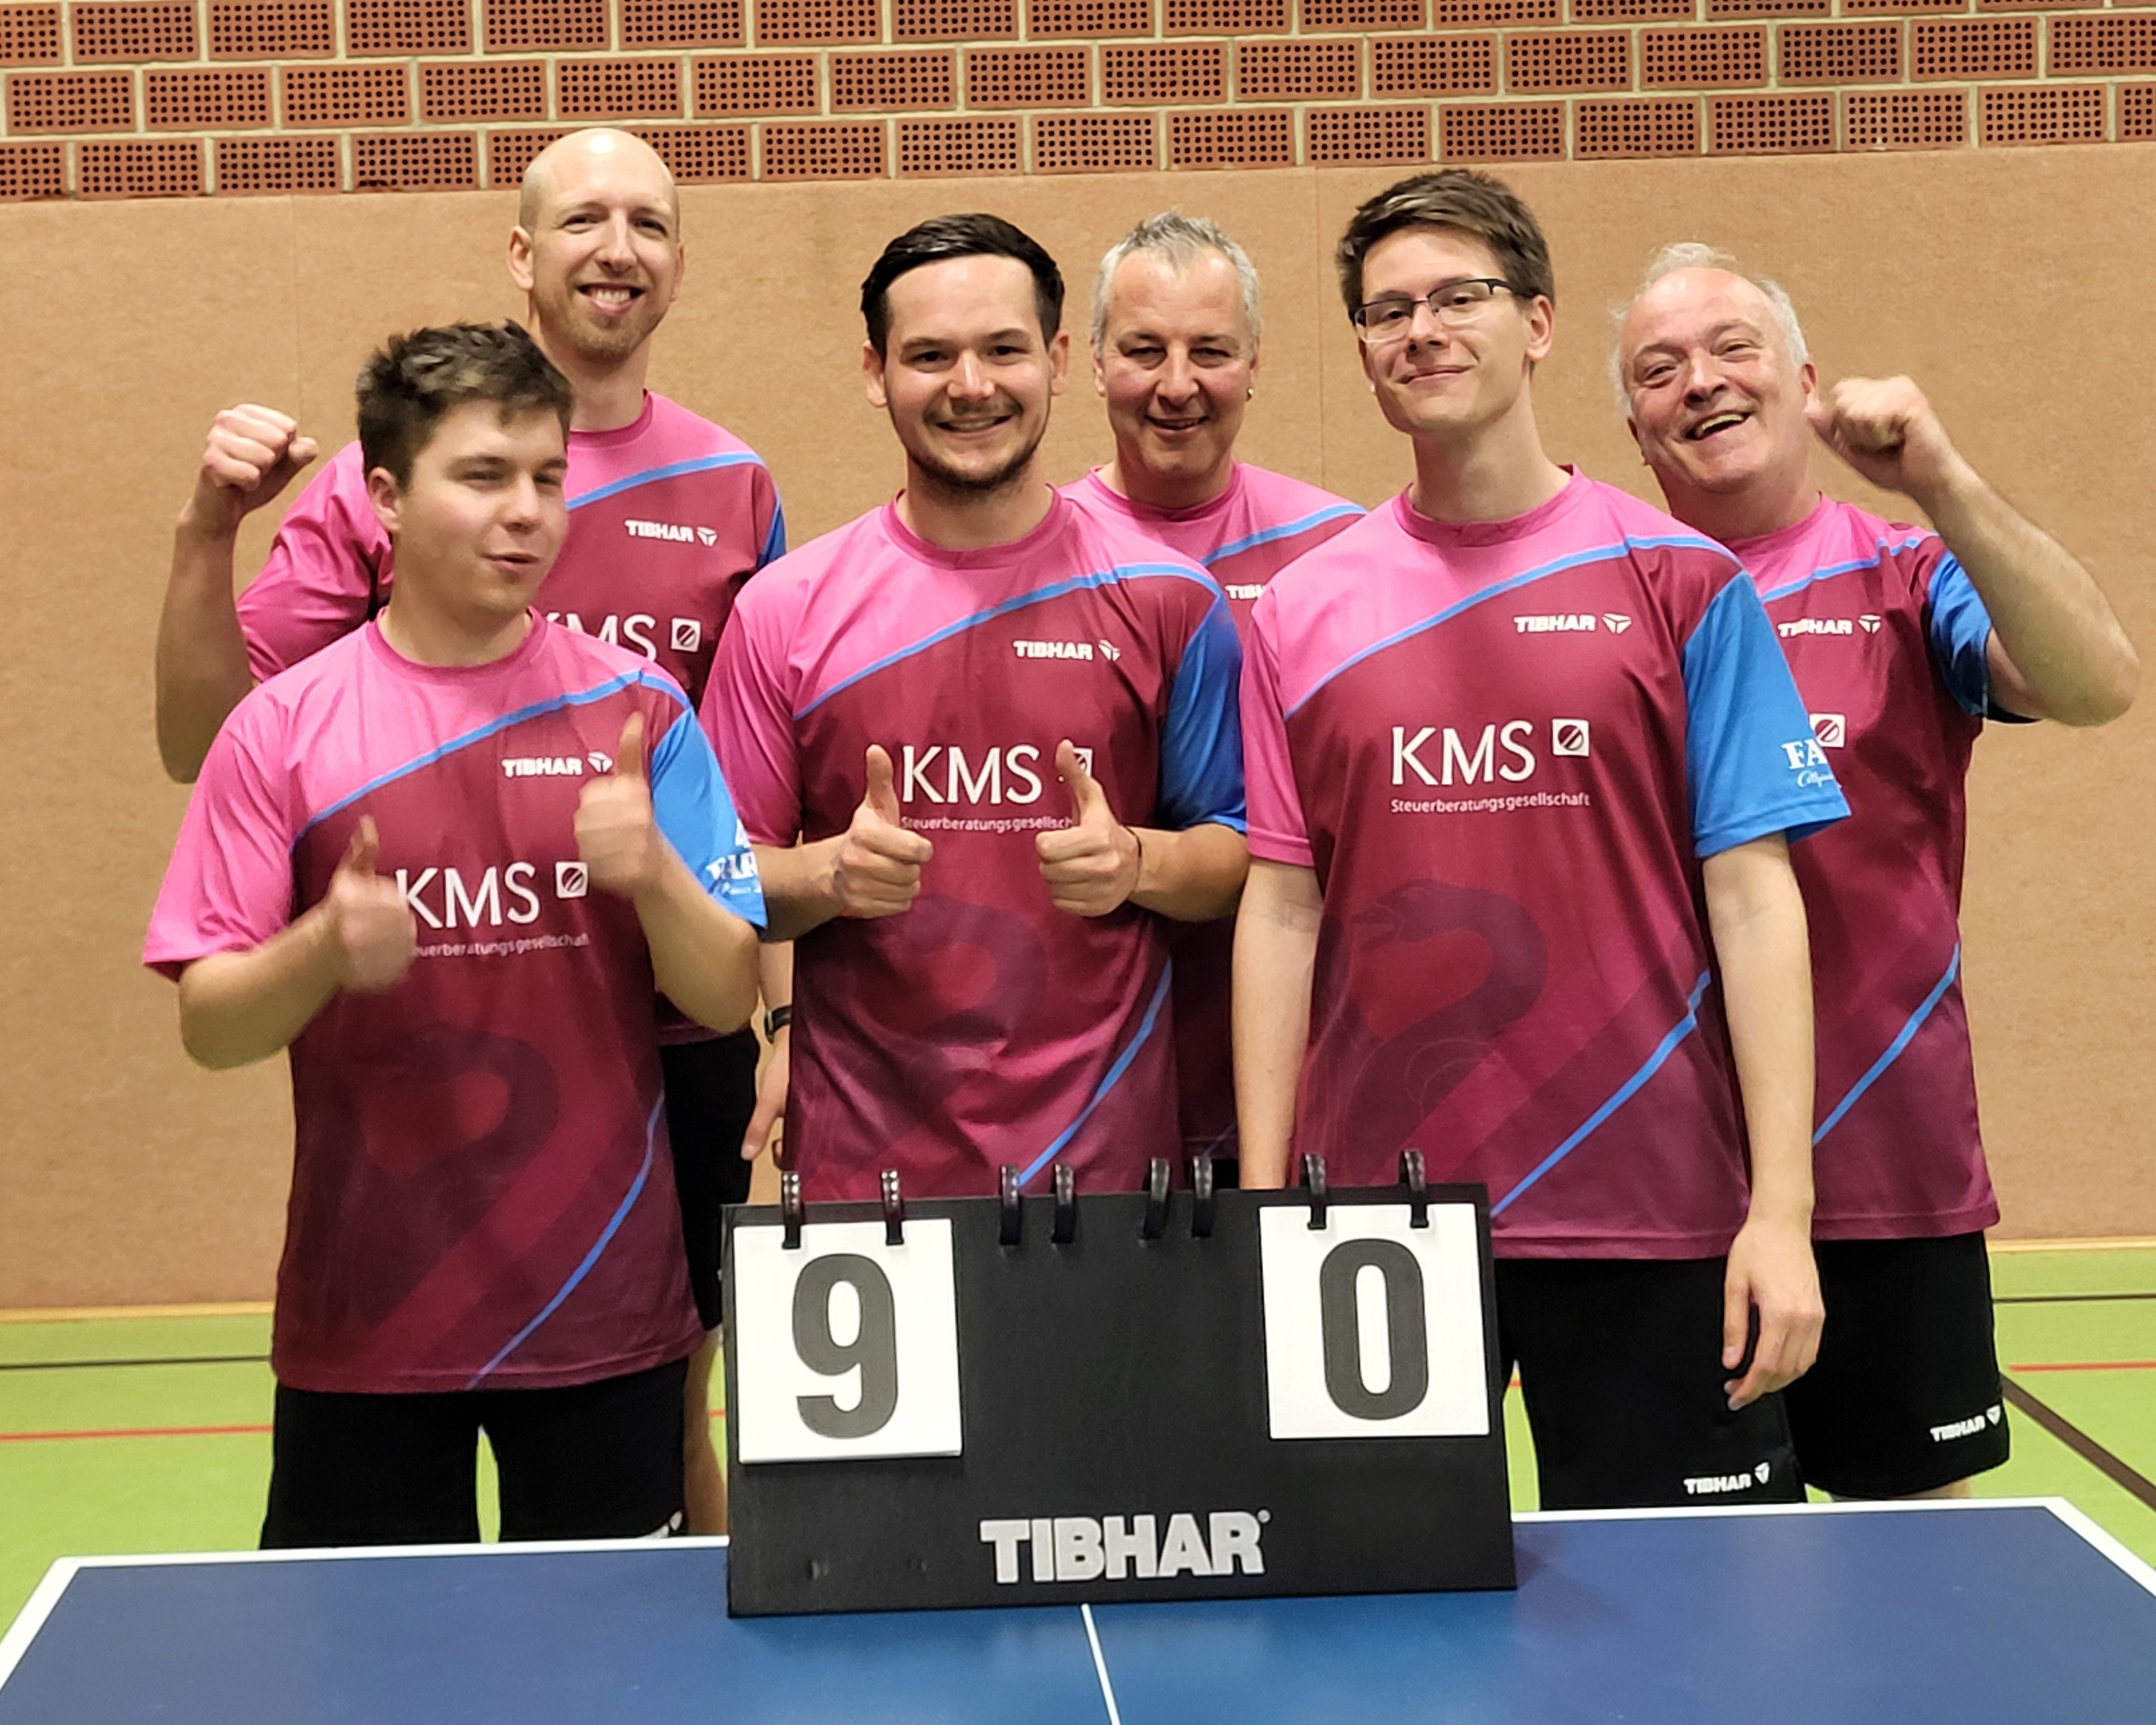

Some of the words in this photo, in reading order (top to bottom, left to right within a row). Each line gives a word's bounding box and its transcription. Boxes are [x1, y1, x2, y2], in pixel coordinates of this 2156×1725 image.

[625, 520, 694, 542] TIBHAR
[1514, 615, 1596, 633] TIBHAR
[1013, 641, 1093, 661] TIBHAR
[1392, 720, 1537, 785] KMS
[502, 758, 583, 777] TIBHAR
[902, 744, 1042, 804] KMS
[1391, 792, 1590, 813] Steuerberatungsgesellschaft
[901, 816, 1072, 833] Steuerberatungsgesellsch
[395, 862, 541, 927] KMS
[1319, 1238, 1429, 1421] 0
[791, 1252, 899, 1439] 9
[1683, 1473, 1752, 1495] TIBHAR
